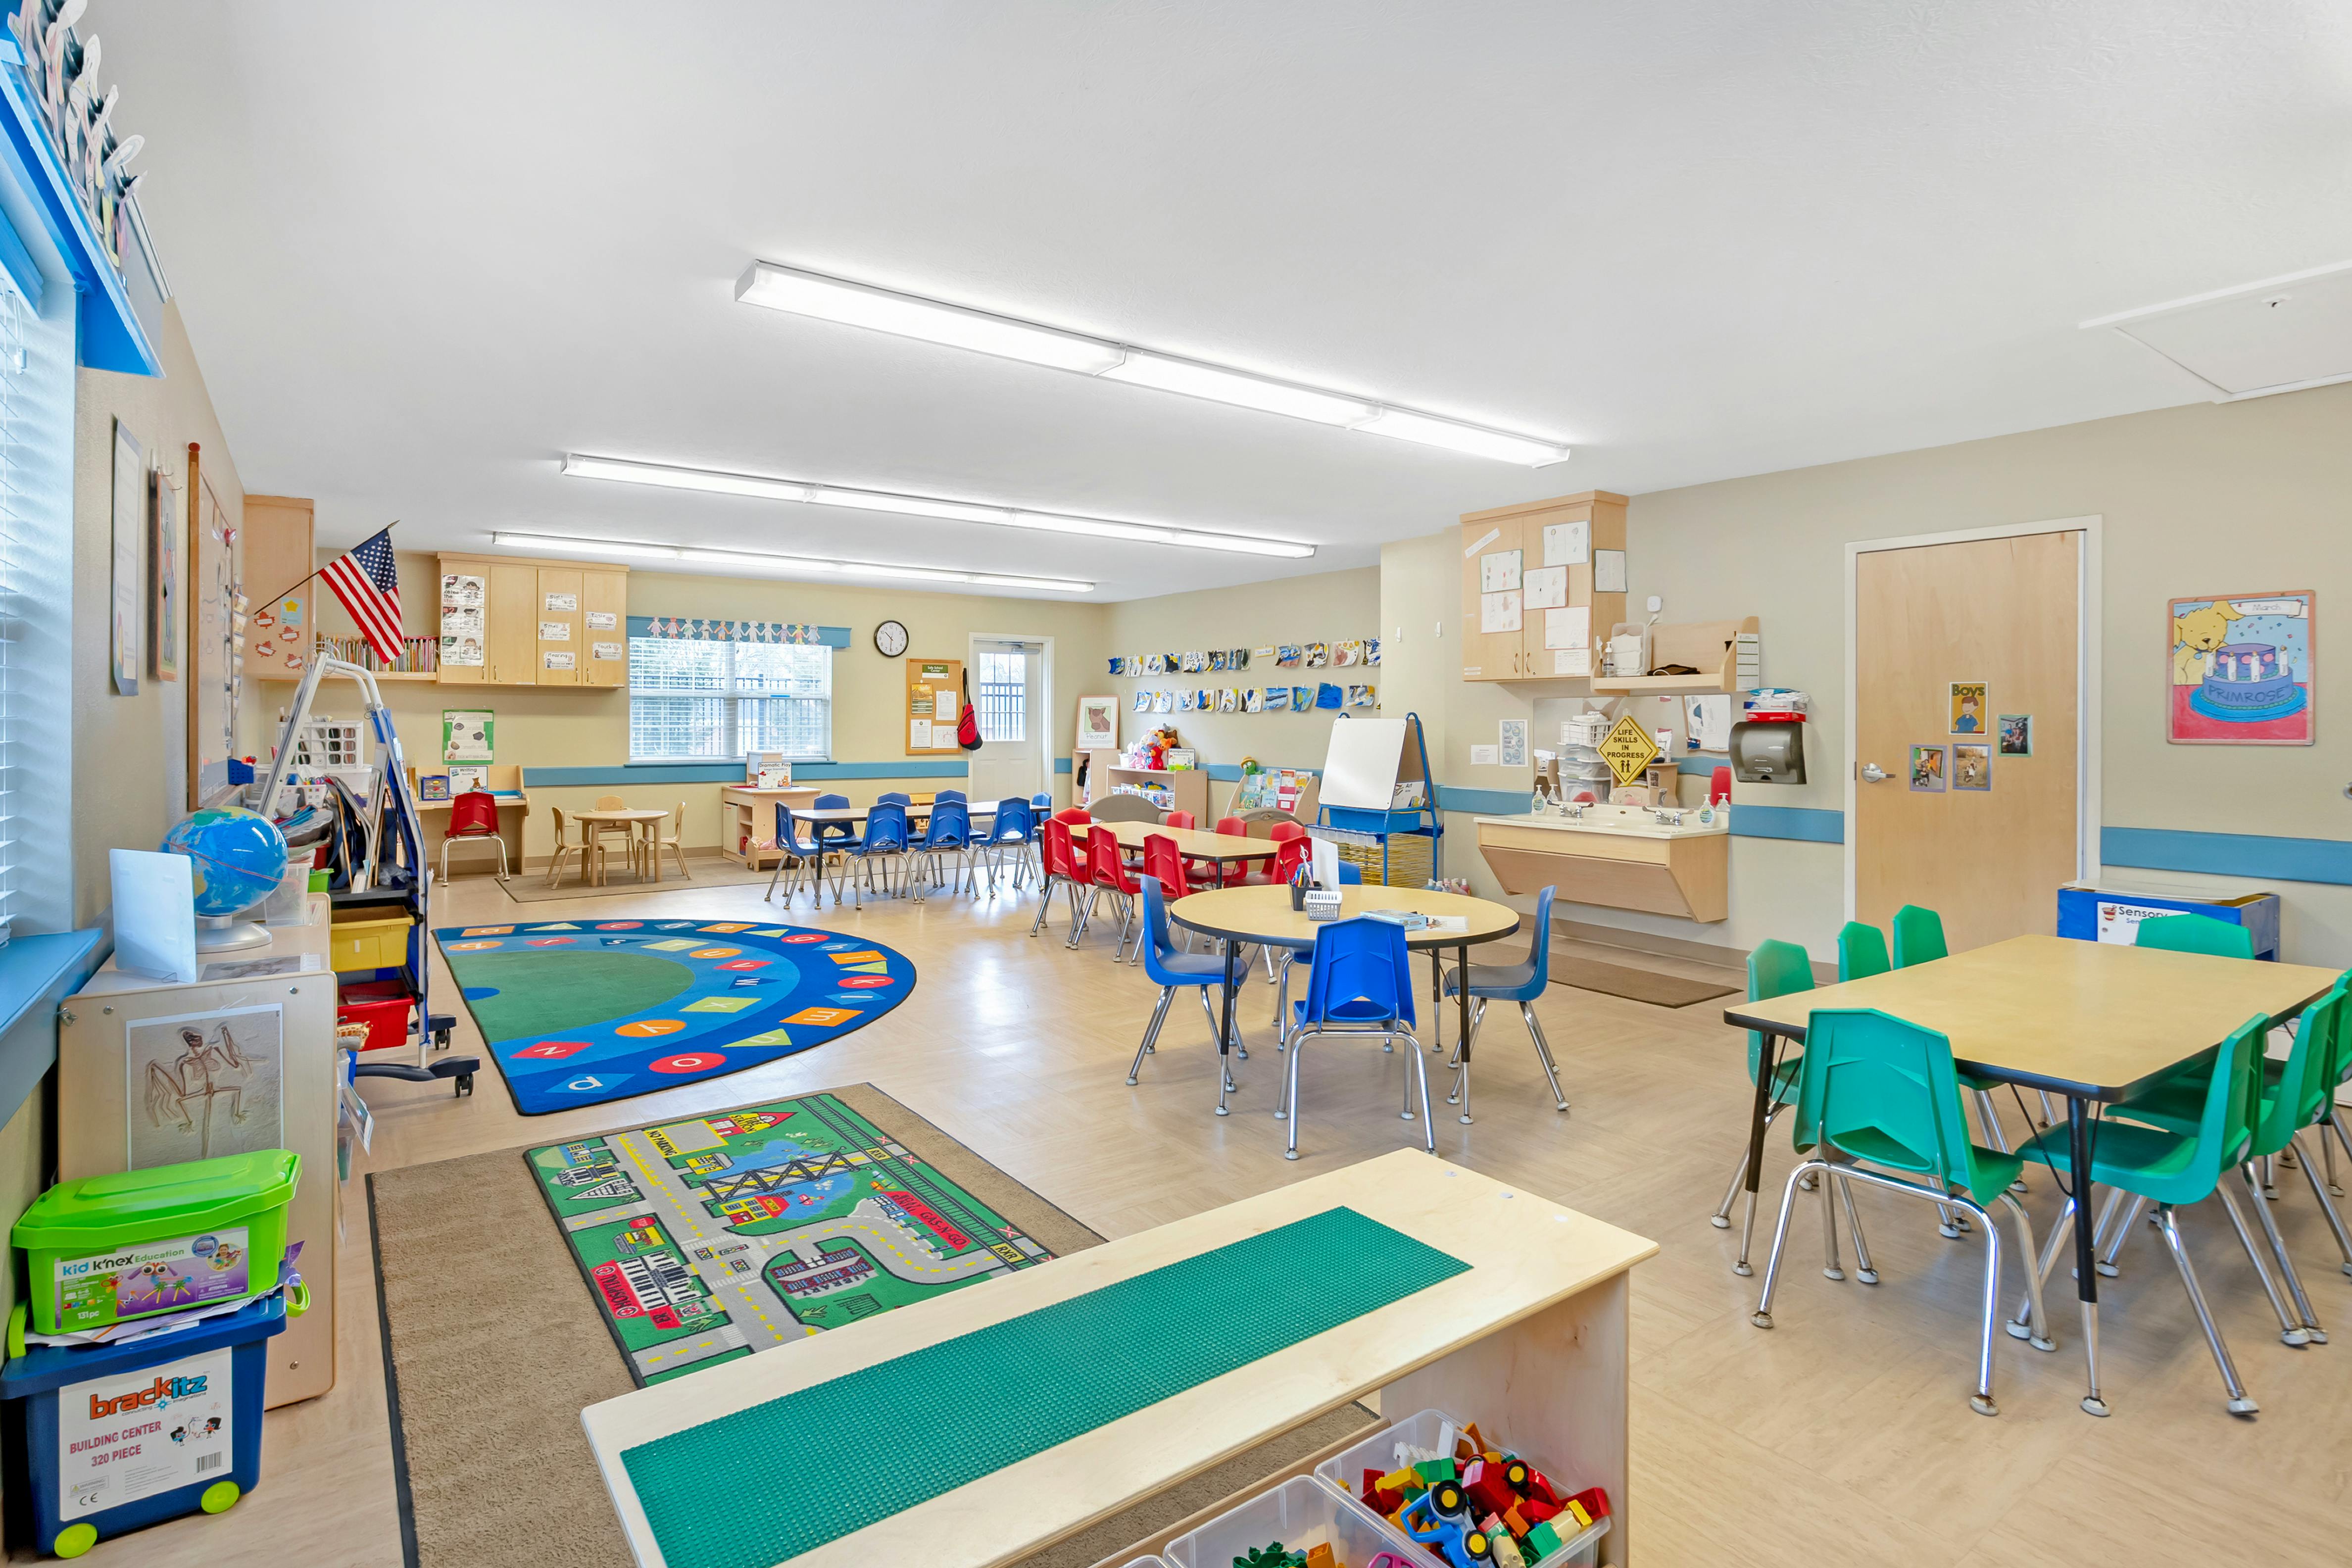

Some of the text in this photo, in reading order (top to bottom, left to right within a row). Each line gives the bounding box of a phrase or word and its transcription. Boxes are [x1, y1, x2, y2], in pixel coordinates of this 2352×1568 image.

[1952, 684, 1985, 697] Boys
[2208, 685, 2285, 703] PRIMROSE
[2119, 906, 2168, 918] Sensory
[803, 1011, 840, 1021] m
[671, 1057, 702, 1067] o
[731, 1115, 757, 1132] STATION
[647, 1130, 678, 1157] NO PARKING
[868, 1149, 886, 1160] RXR
[920, 1211, 967, 1245] GAS-N-GO
[994, 1245, 1019, 1260] RXR
[63, 1249, 185, 1275] kid k'nex Education
[600, 1274, 632, 1309] HOSPITAL
[803, 1273, 870, 1297] LIBRARY
[653, 1312, 672, 1324] ER
[90, 1375, 207, 1421] brackitz
[173, 1391, 207, 1404] imaginations
[70, 1421, 162, 1455] BUILDING CENTER
[91, 1444, 142, 1468] 320 PIECE
